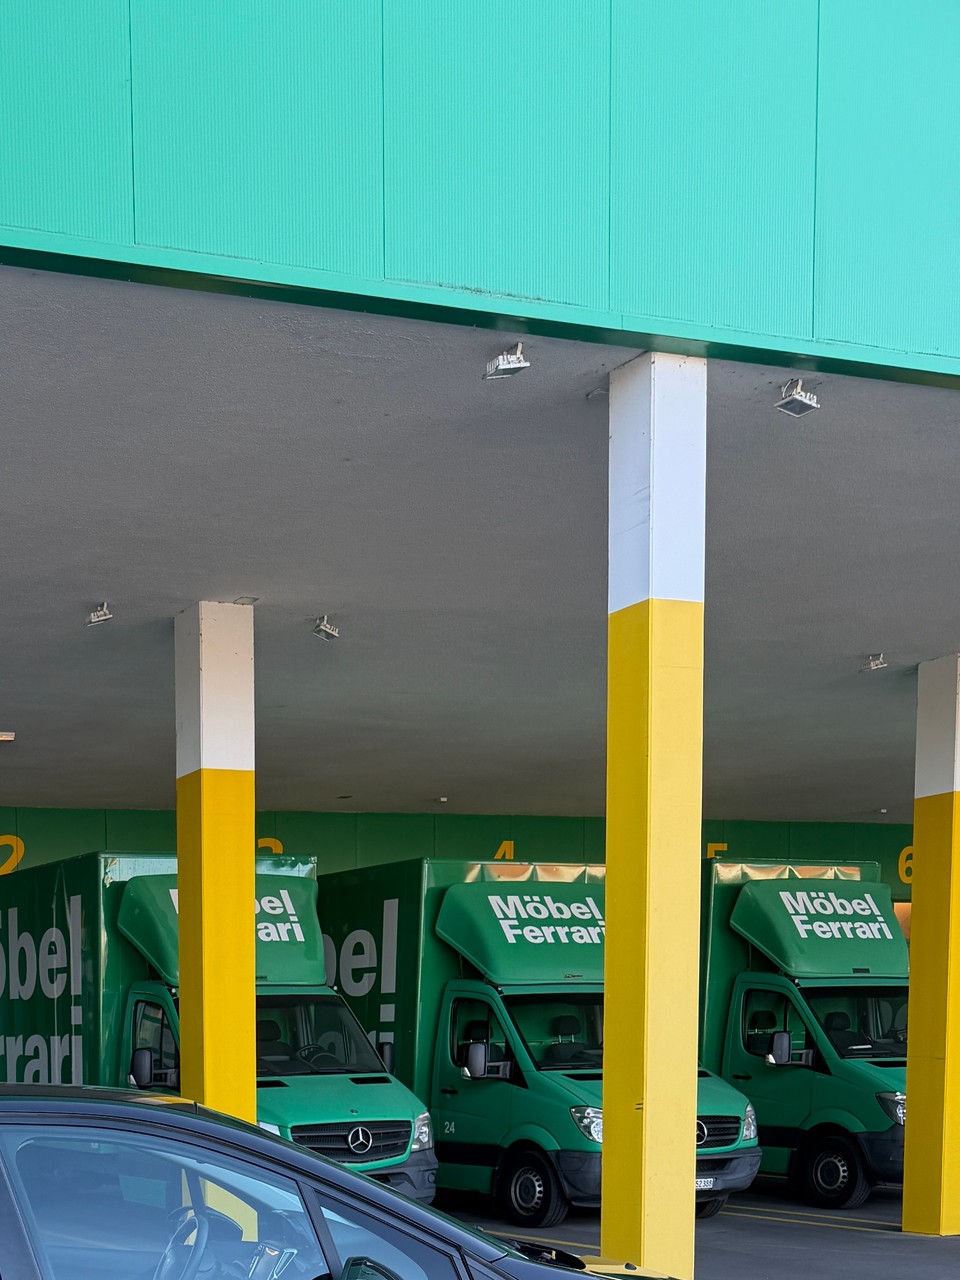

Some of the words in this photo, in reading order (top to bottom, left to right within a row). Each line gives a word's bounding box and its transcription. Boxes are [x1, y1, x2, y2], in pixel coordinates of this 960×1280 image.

[487, 895, 603, 919] Möbel
[779, 891, 882, 916] Möbel
[790, 914, 894, 940] Ferrari
[444, 1121, 456, 1134] 24
